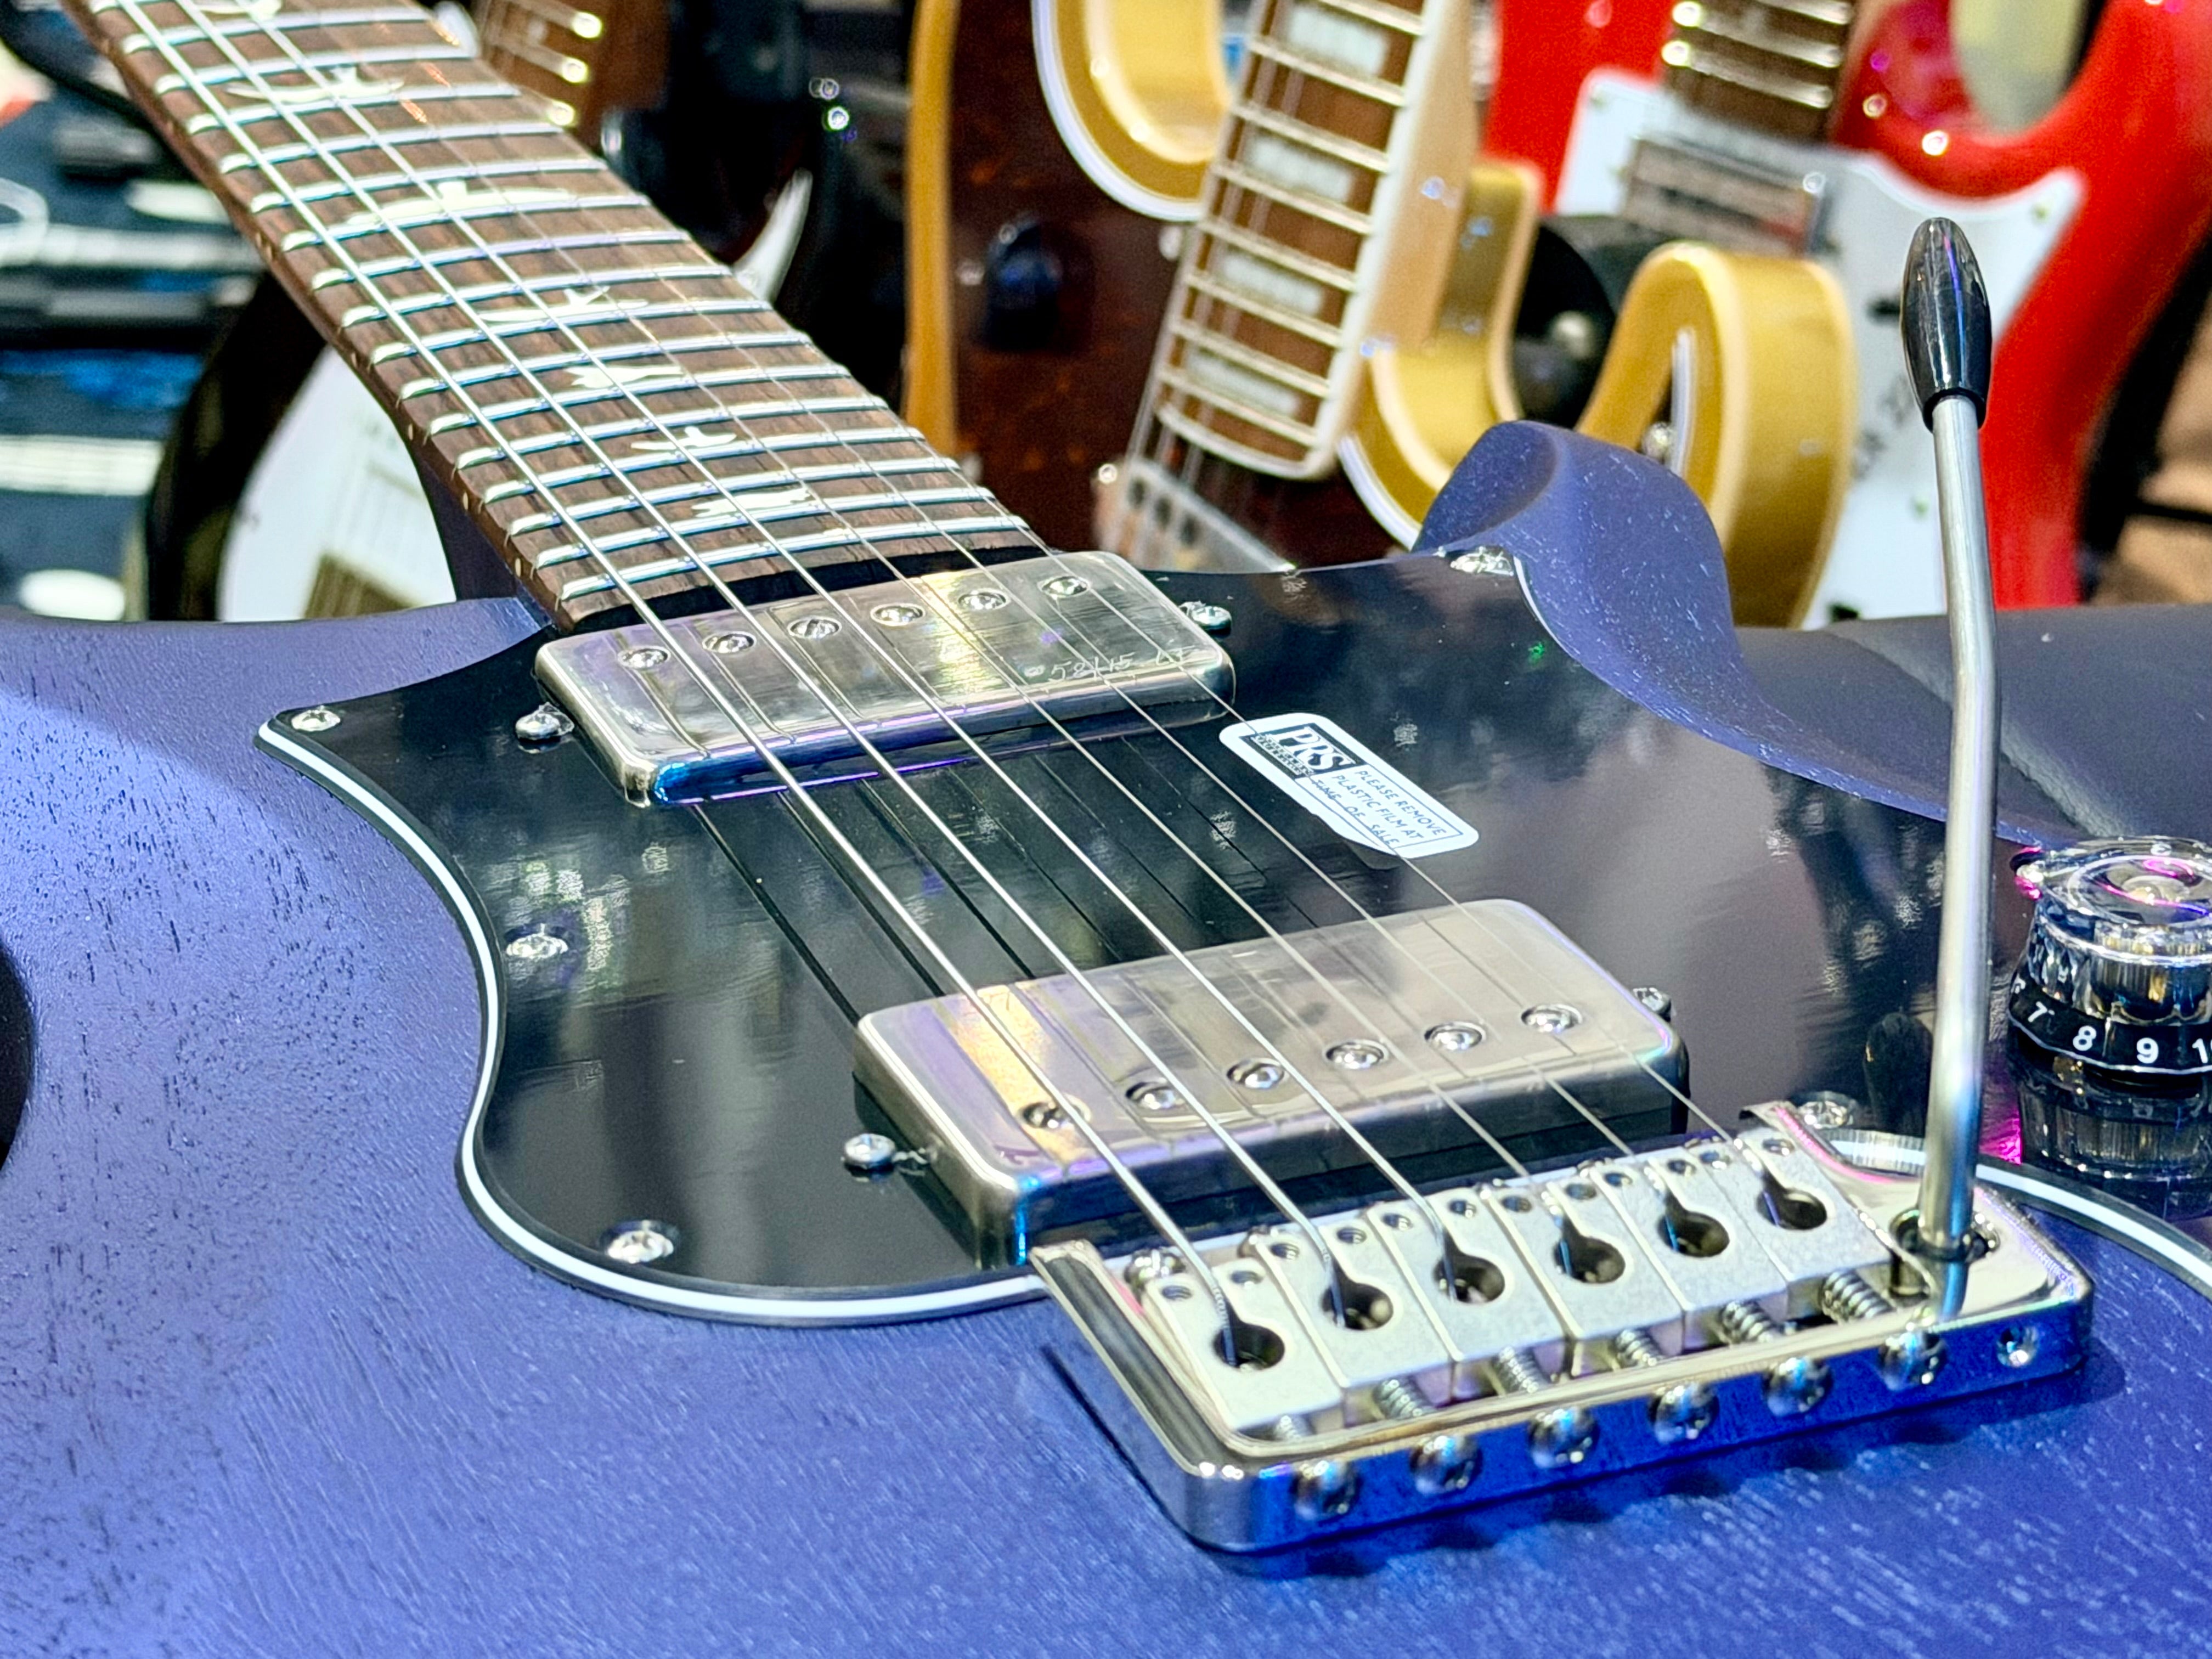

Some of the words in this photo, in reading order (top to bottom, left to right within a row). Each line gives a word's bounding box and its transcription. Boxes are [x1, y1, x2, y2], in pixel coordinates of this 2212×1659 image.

[1268, 726, 1352, 770] PRS
[1331, 775, 1381, 809] PLASTIC
[1375, 808, 1408, 828] FILM
[1401, 829, 1425, 839] AT
[1355, 770, 1399, 800] PLEASE
[1394, 800, 1447, 836] REMOVE
[1371, 824, 1400, 845] SALE
[2073, 1026, 2097, 1051] 8
[2136, 1038, 2159, 1064] 9
[2192, 1038, 2212, 1063] 1
